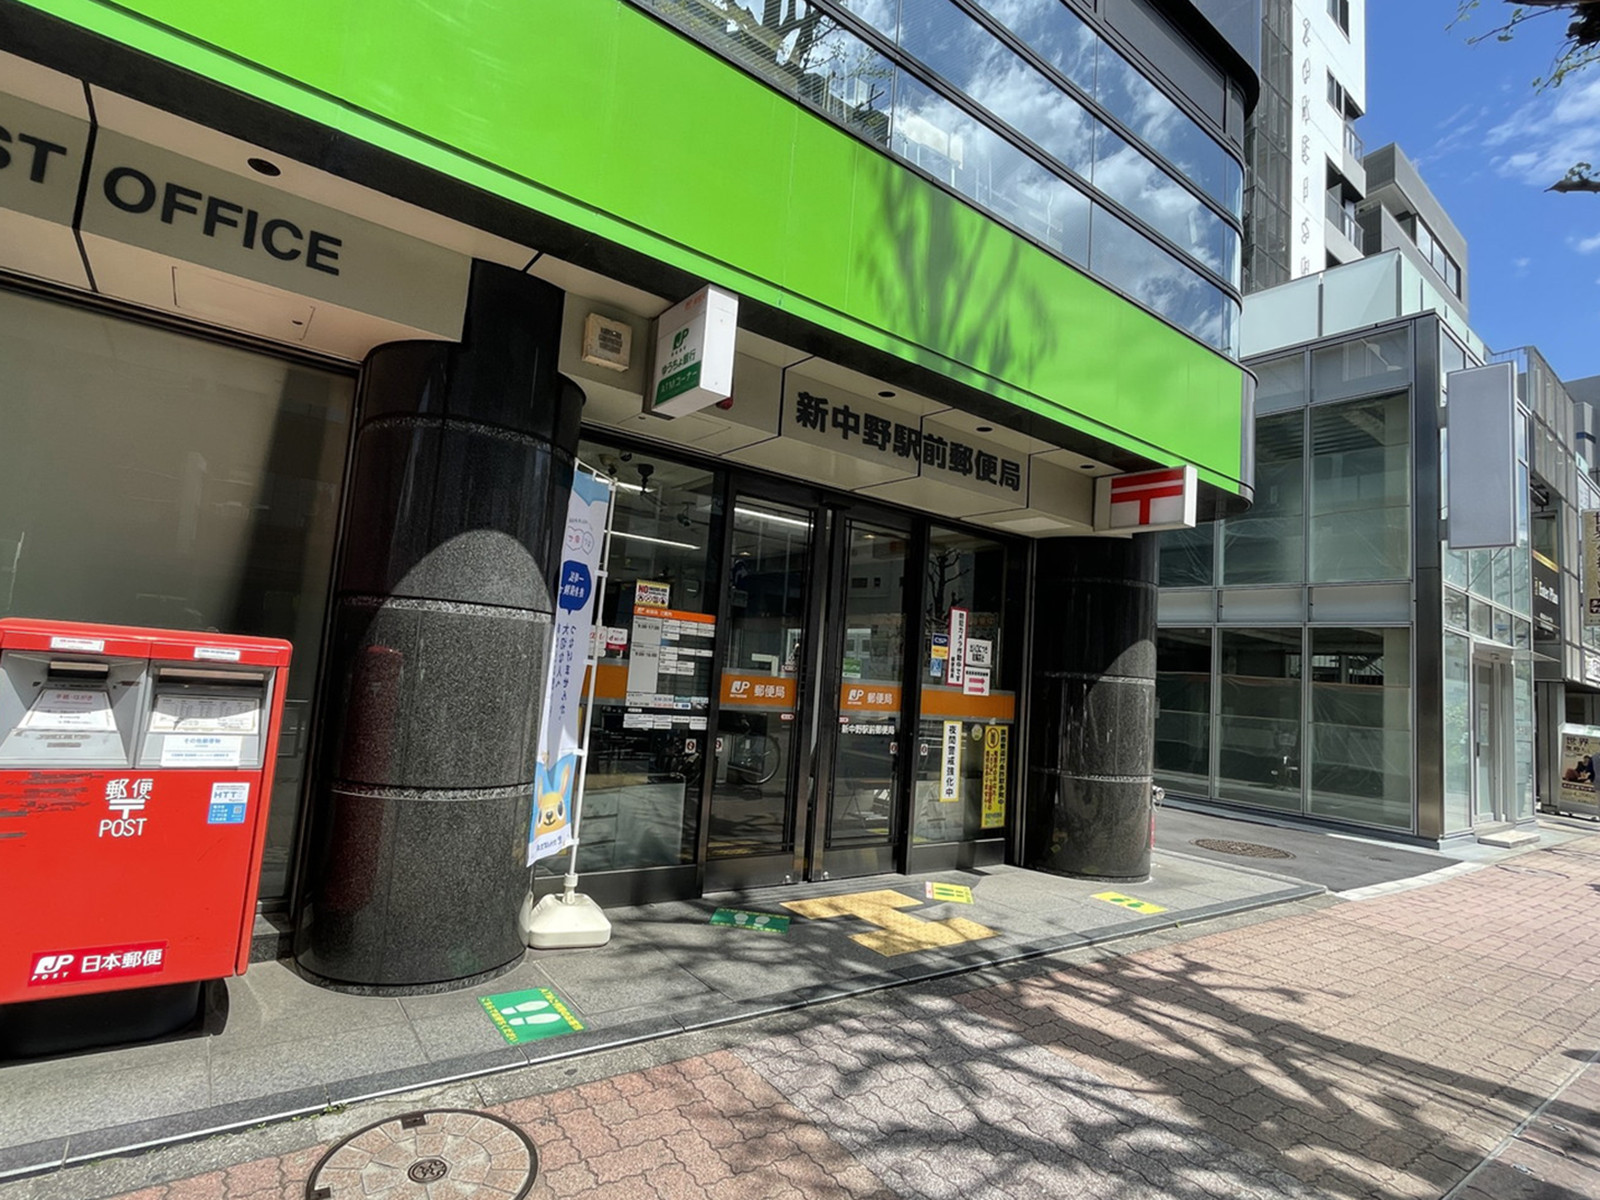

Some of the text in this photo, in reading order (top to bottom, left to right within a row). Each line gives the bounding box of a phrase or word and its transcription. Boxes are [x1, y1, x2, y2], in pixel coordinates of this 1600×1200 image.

[103, 166, 343, 276] OFFICE
[661, 349, 696, 375] ゆうちょ銀行
[796, 391, 1021, 491] 新中野駅前郵便局
[754, 684, 786, 699] 郵便局
[866, 692, 893, 705] 郵便局
[841, 724, 895, 735] 新中野駅前郵便局
[105, 778, 154, 801] 郵便
[98, 817, 148, 838] POST
[81, 948, 163, 974] 日本郵便
[31, 971, 69, 982] POST
